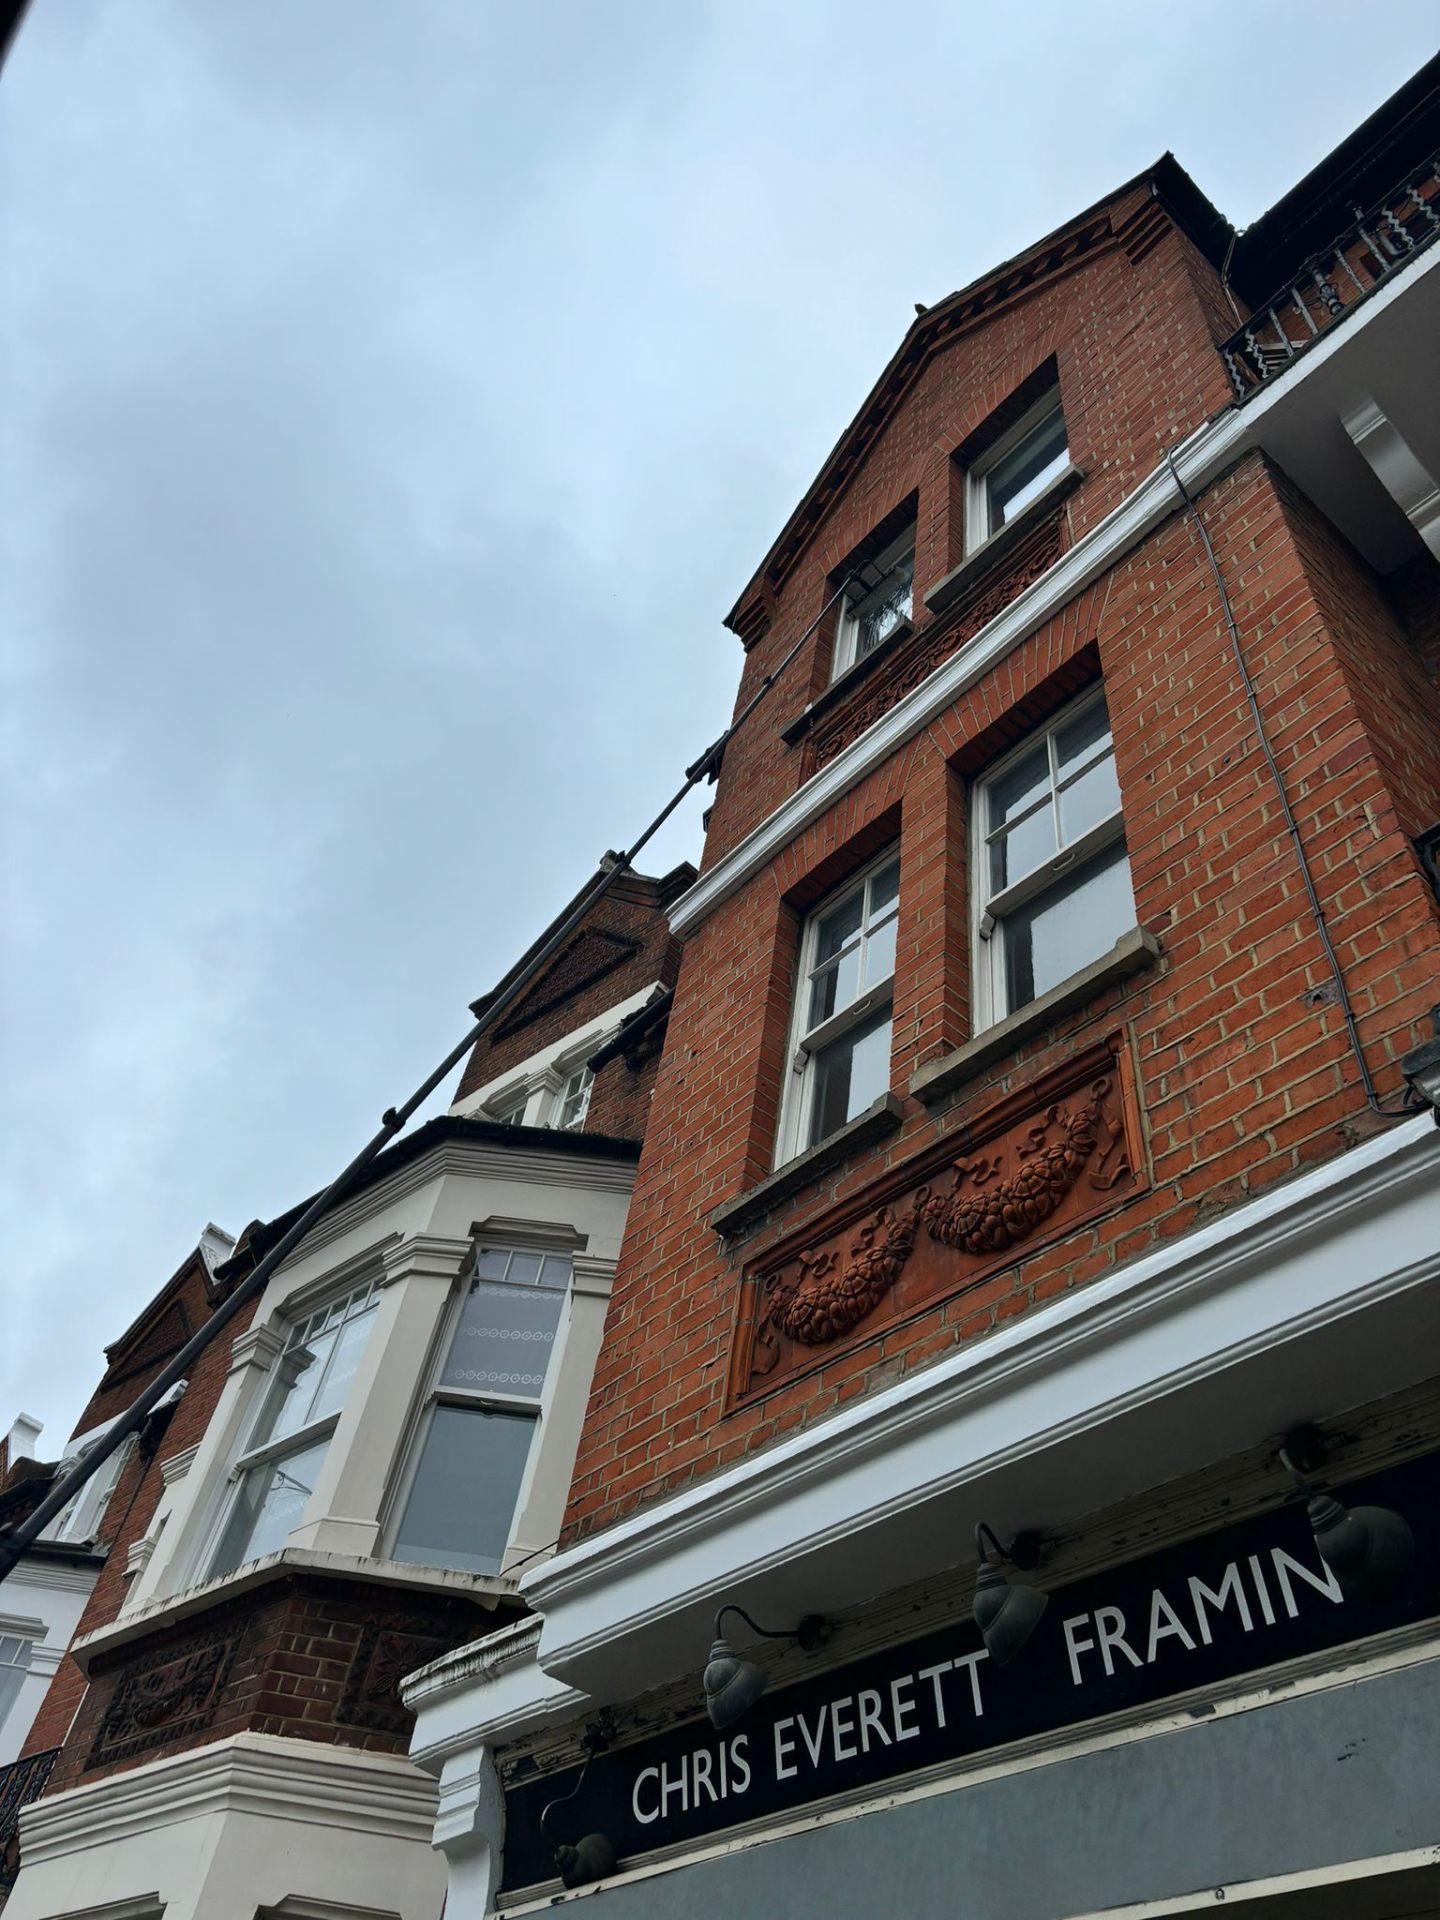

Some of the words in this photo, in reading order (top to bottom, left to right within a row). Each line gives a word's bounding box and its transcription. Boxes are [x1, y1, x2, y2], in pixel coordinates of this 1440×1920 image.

[631, 1733, 751, 1825] CHRIS
[774, 1649, 990, 1780] EVERETT
[1062, 1534, 1345, 1685] FRAMIN
